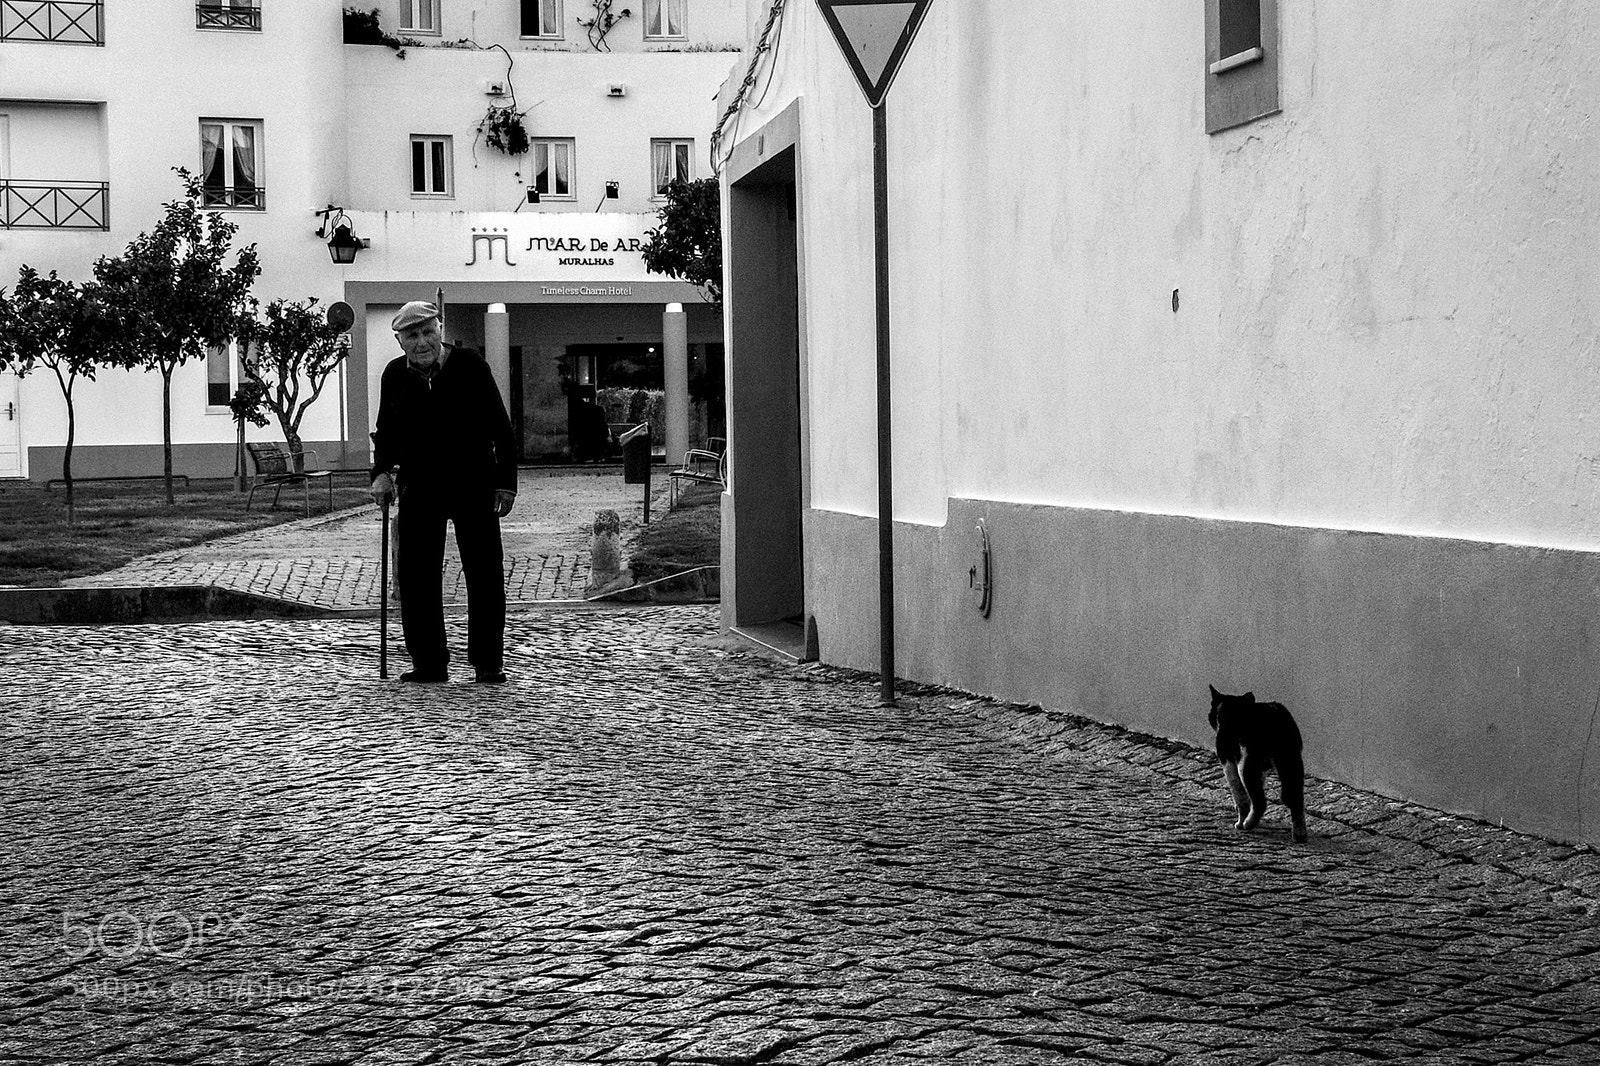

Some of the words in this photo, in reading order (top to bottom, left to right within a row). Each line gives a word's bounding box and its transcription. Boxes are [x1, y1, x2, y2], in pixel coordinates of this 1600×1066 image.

[558, 257, 615, 266] MURALHAS
[541, 286, 580, 297] Timeless
[580, 286, 607, 297] Charm
[608, 286, 632, 297] Hotel
